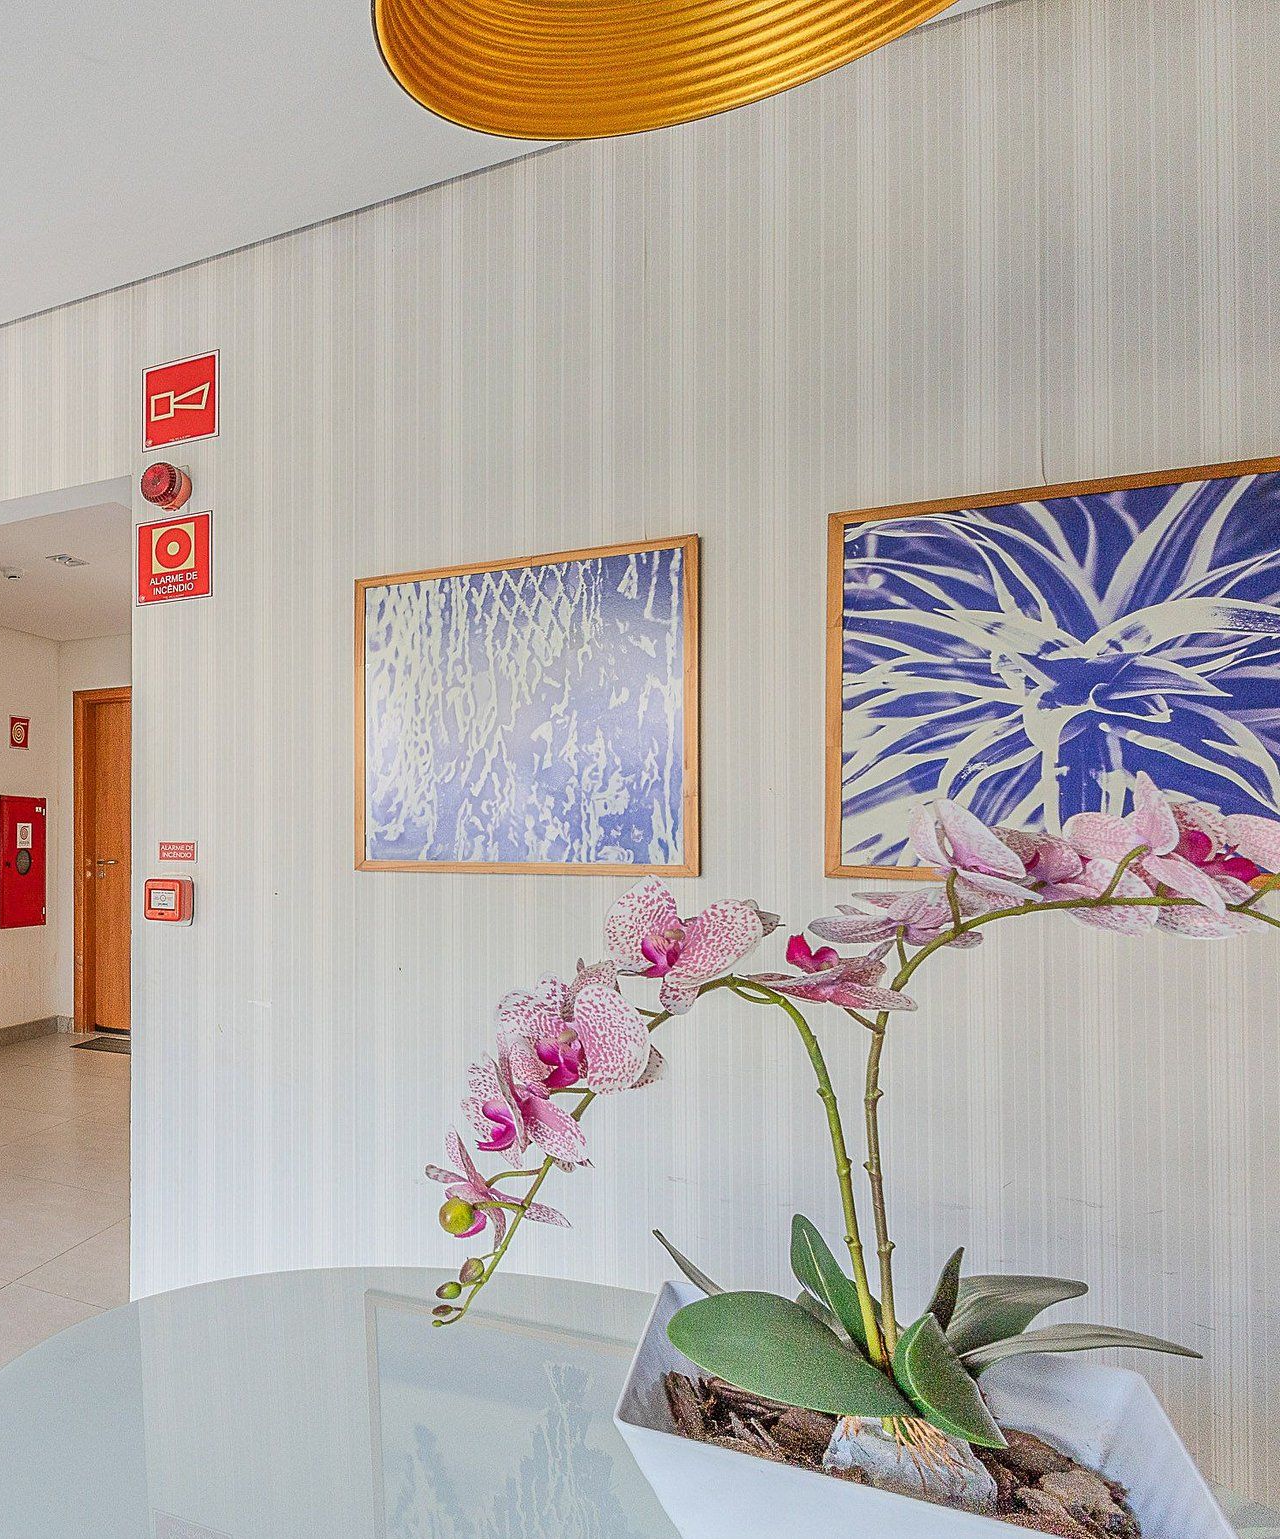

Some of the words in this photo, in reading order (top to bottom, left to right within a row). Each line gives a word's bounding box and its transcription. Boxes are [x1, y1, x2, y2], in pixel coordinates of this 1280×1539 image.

[150, 573, 184, 586] ALARME
[185, 571, 198, 581] DE
[153, 582, 194, 595] INCÊNDIO
